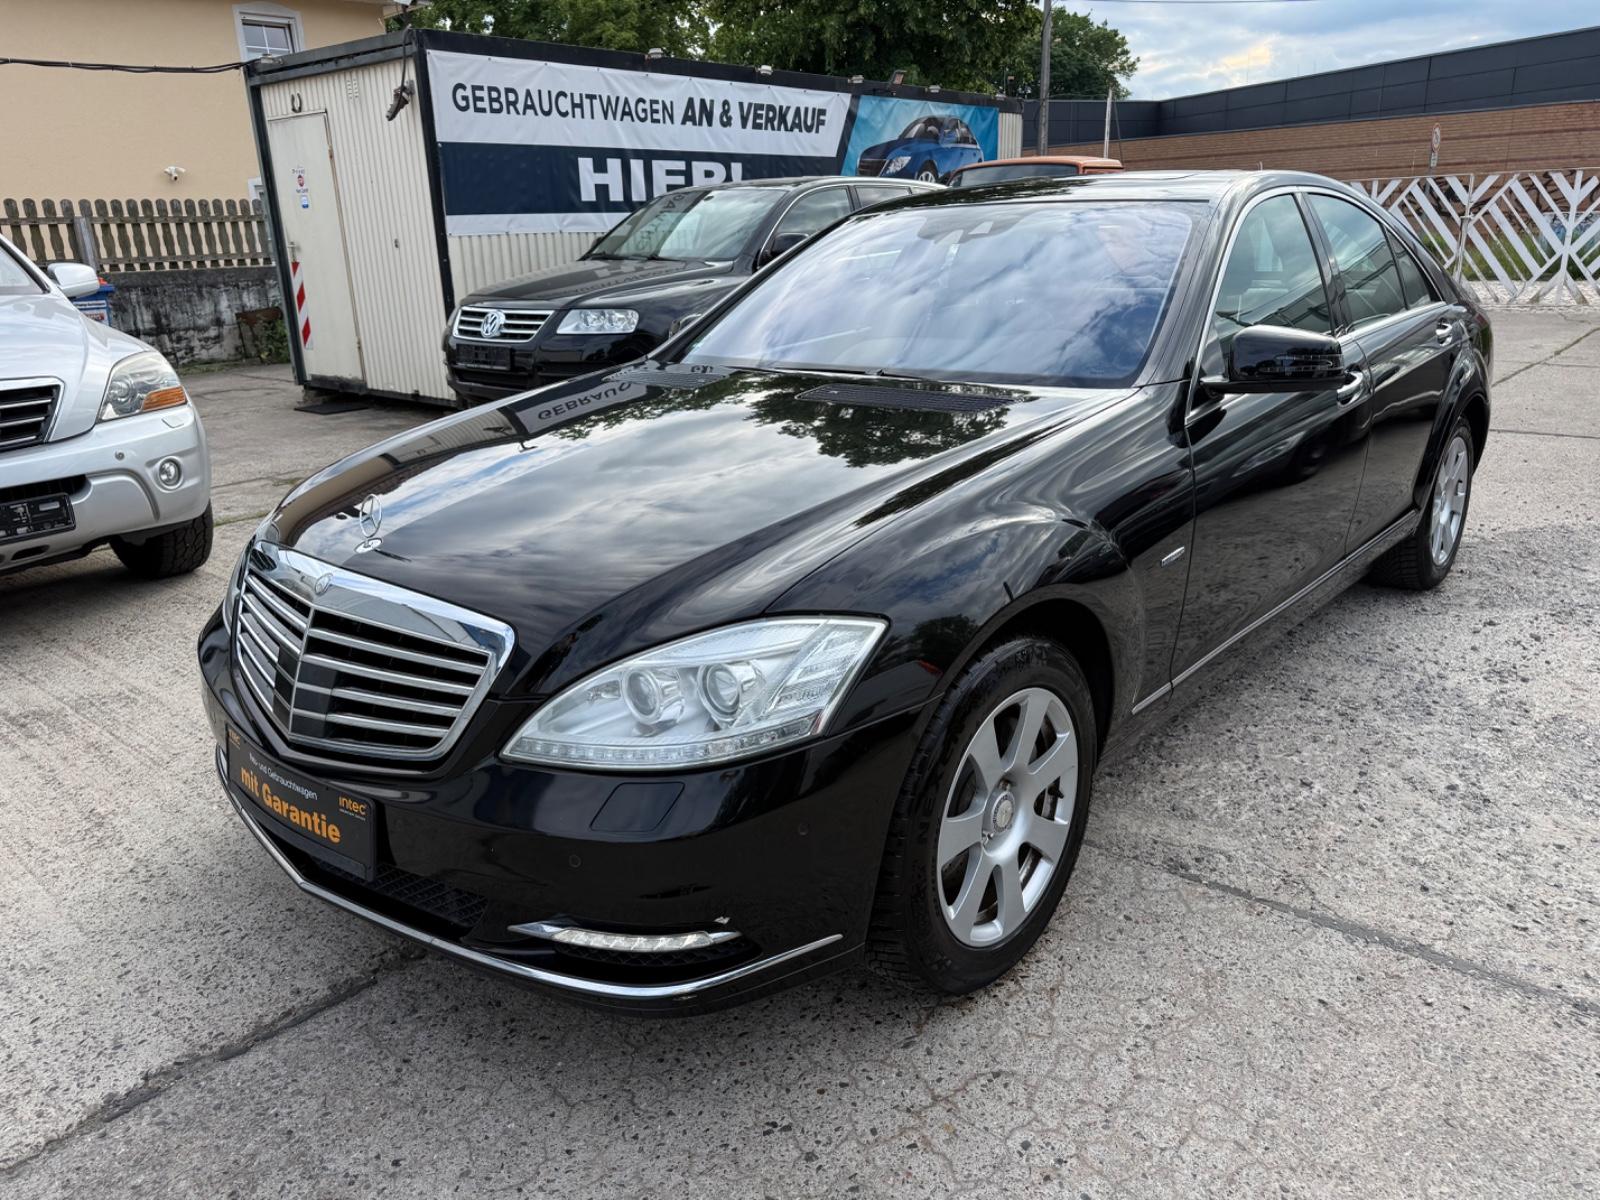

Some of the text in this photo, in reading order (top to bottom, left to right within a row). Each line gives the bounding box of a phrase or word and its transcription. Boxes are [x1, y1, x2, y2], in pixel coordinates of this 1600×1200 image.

[451, 82, 827, 134] GEBRAUCHTWAGEN AN & VERKAUF
[240, 766, 342, 844] mit Garantie
